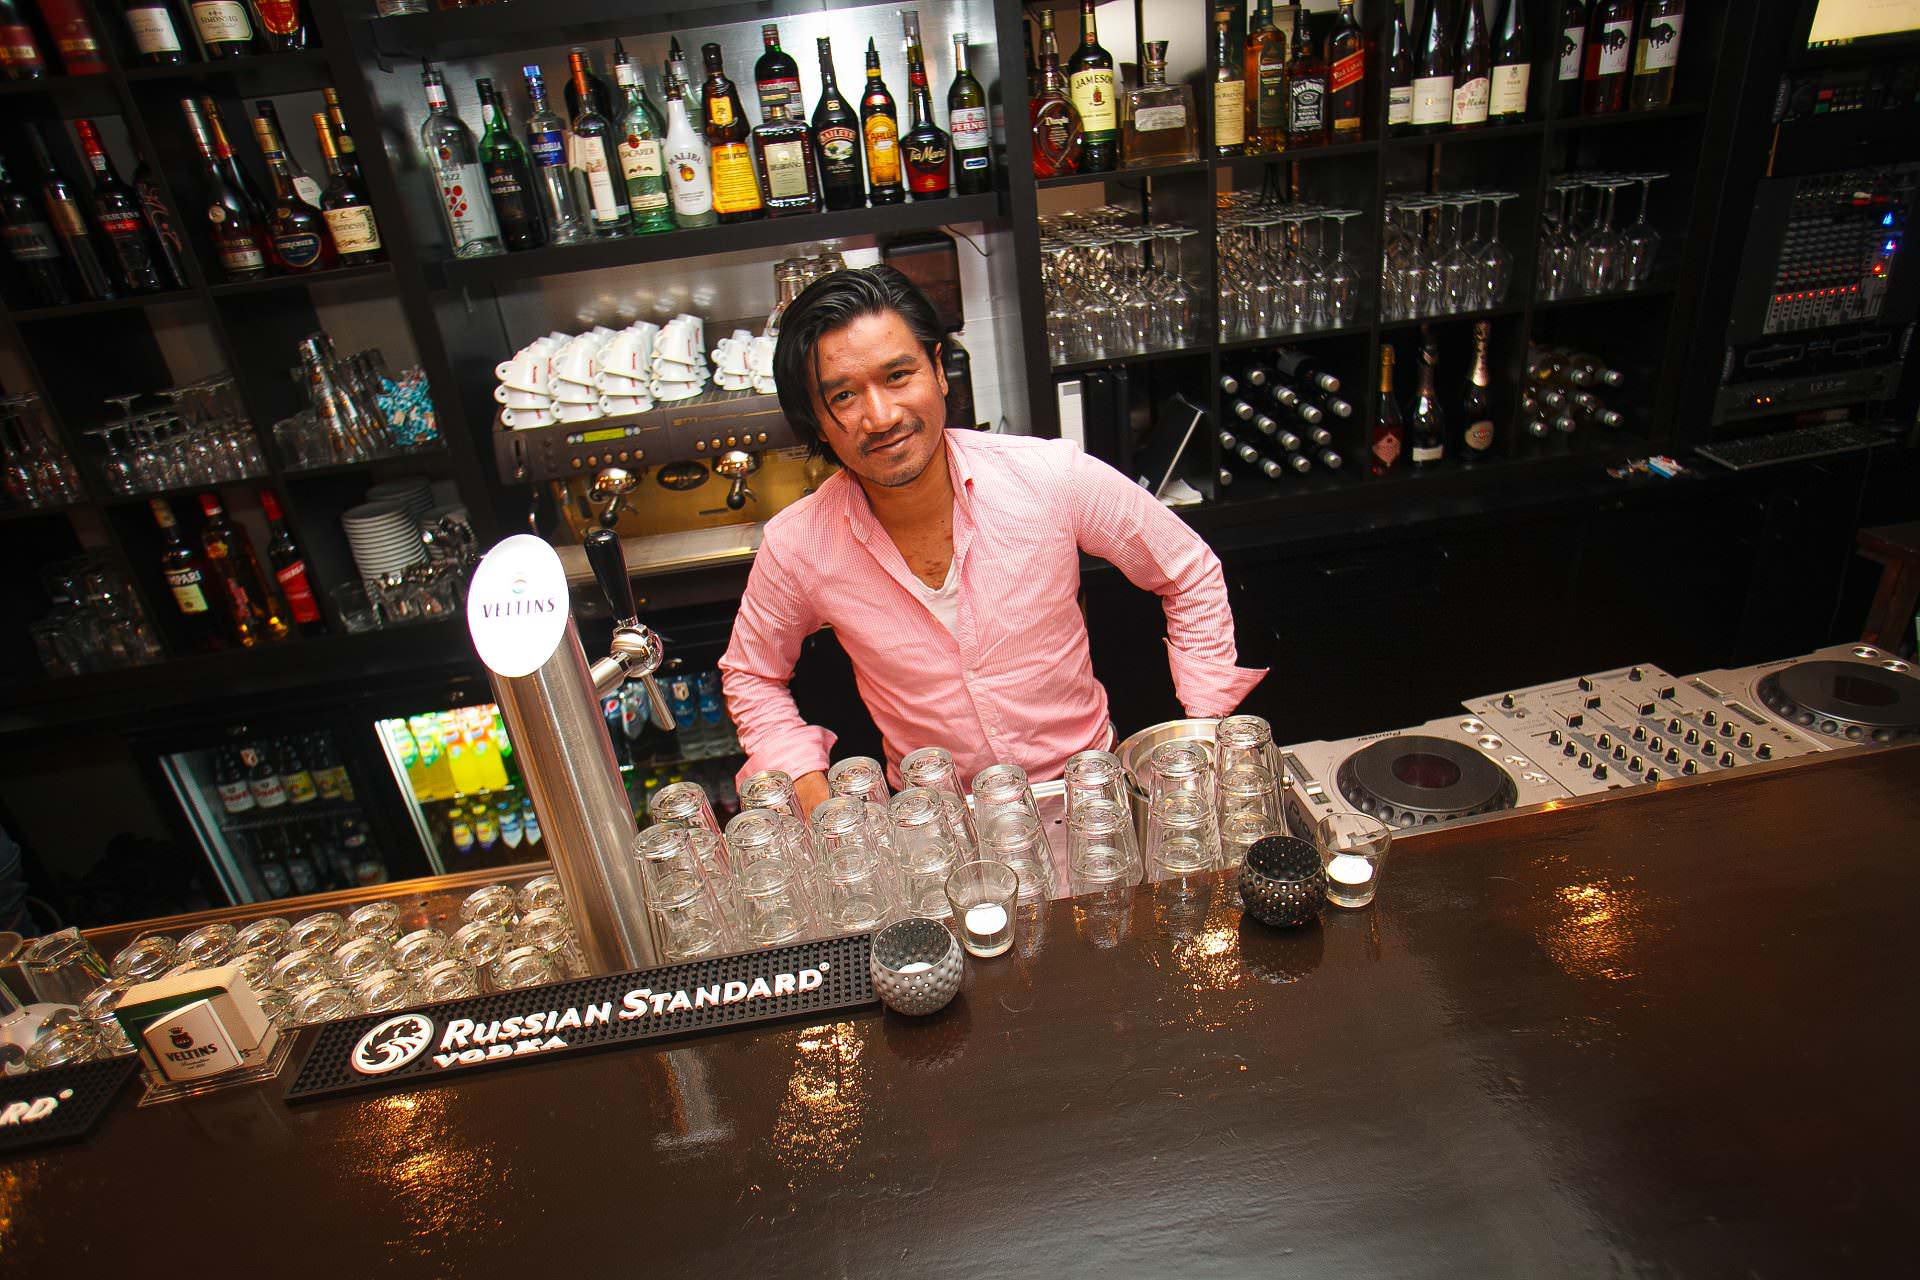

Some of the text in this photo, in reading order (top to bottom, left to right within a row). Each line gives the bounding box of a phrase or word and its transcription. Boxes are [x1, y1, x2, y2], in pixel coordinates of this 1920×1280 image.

[438, 967, 824, 1051] RUSSIAN STANDARD
[165, 1044, 218, 1062] VELTINS
[432, 1034, 569, 1069] VODKA
[0, 1096, 59, 1126] RD
